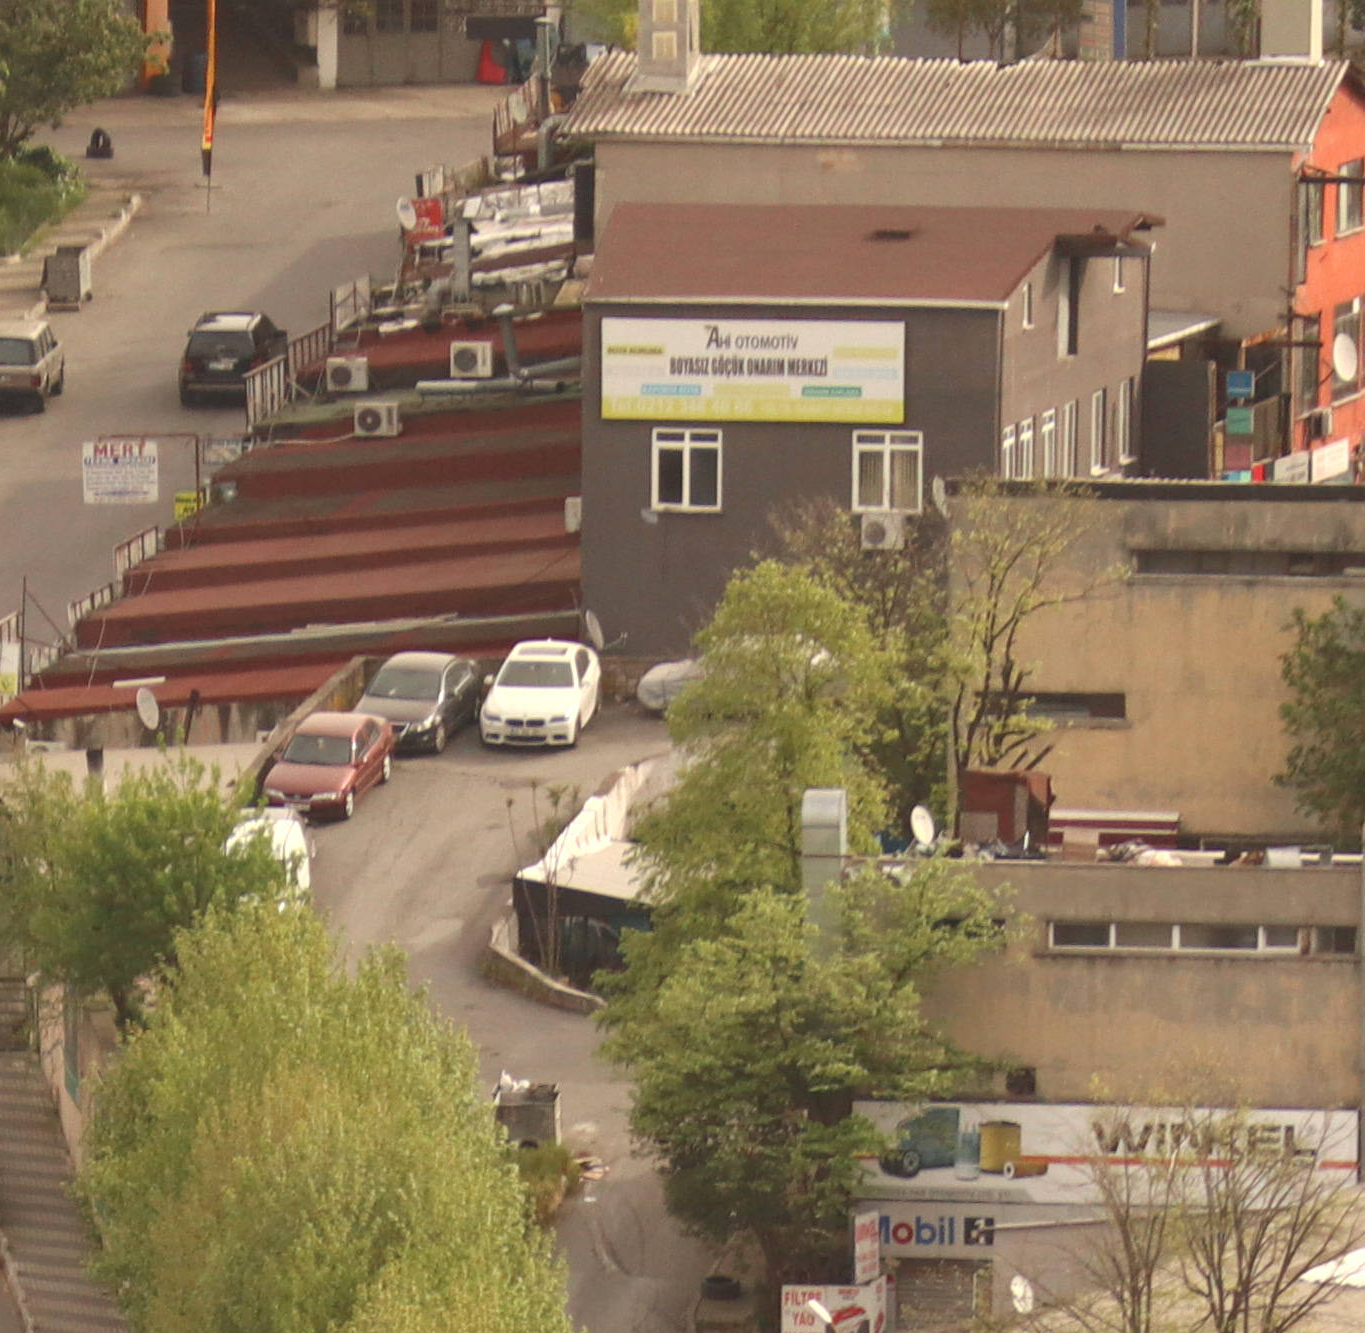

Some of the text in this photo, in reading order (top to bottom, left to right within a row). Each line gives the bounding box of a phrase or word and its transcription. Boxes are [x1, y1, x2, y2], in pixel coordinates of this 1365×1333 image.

[669, 356, 710, 376] BOYASIZ
[747, 357, 785, 377] ONARIM
[787, 354, 828, 377] MERKEZİ
